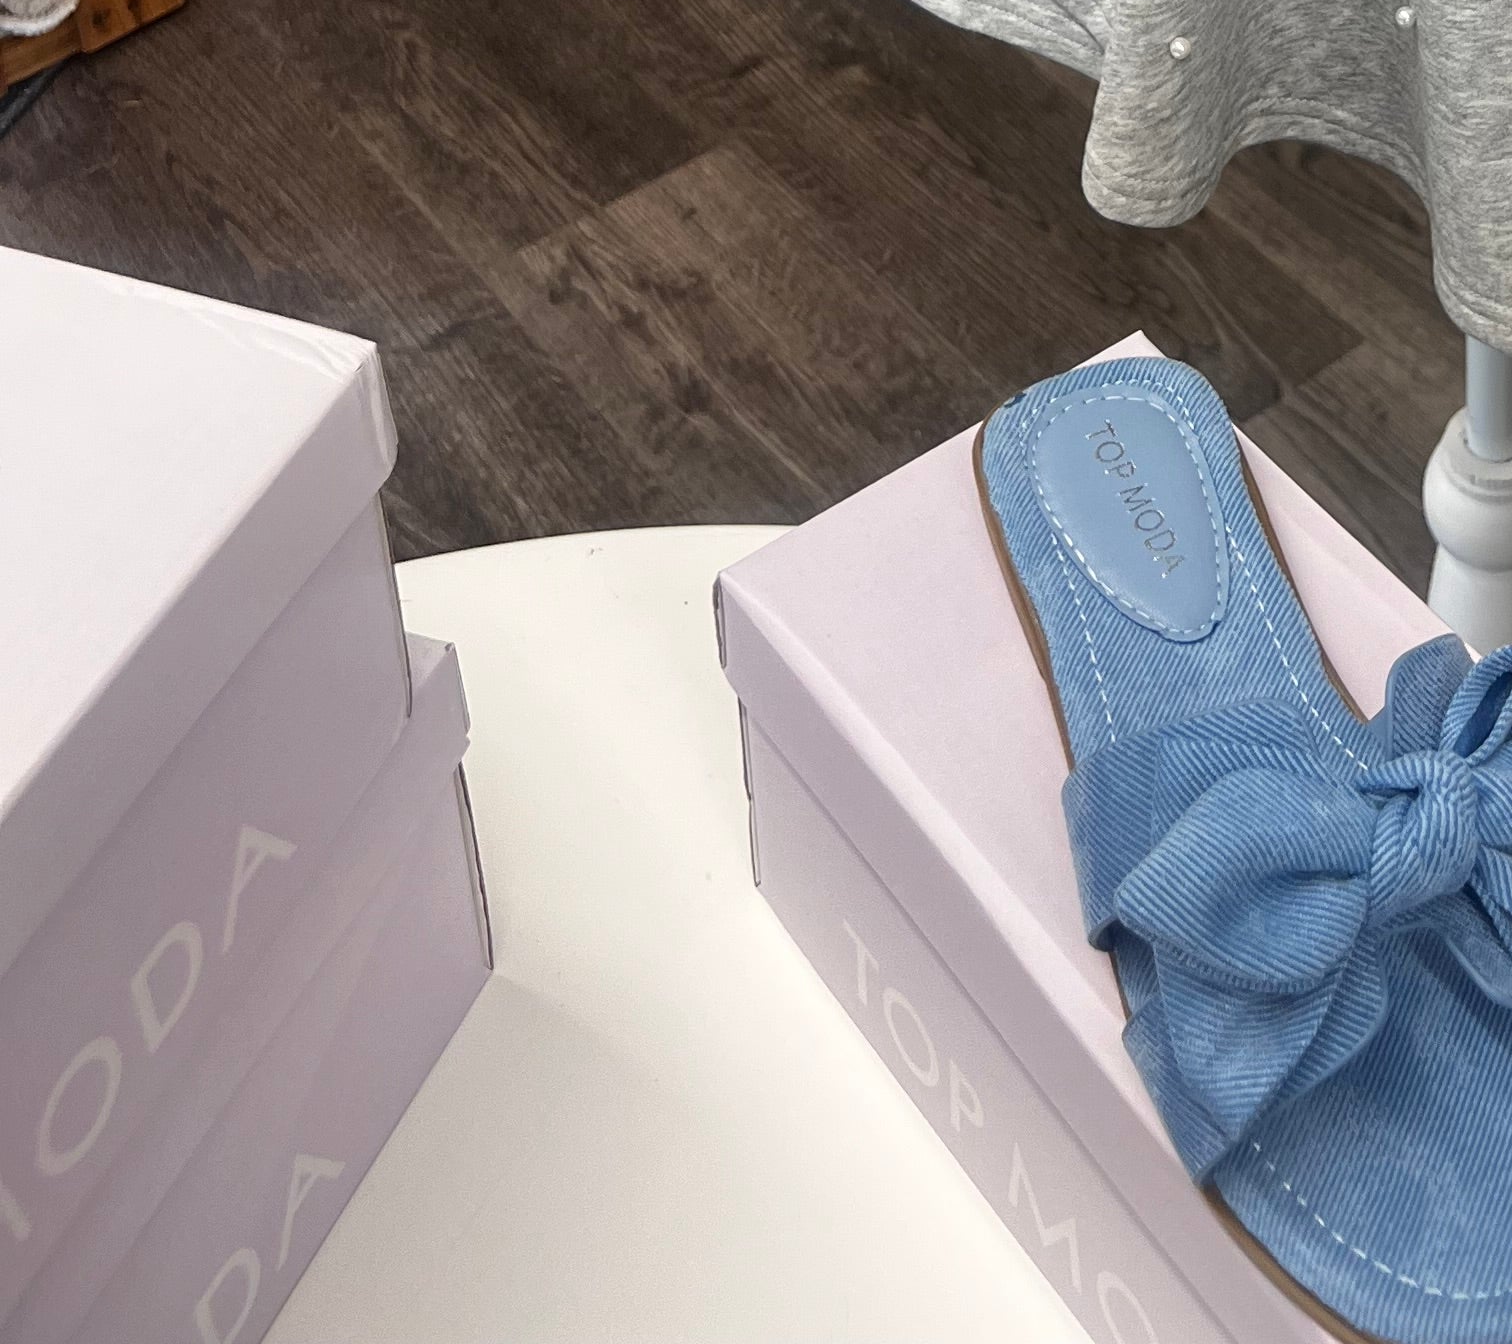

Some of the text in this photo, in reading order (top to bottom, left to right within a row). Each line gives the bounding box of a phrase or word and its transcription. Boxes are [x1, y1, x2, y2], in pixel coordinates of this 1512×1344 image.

[1085, 418, 1186, 579] TOP MODA
[0, 823, 299, 1242] ODA
[842, 916, 986, 1134] TOP
